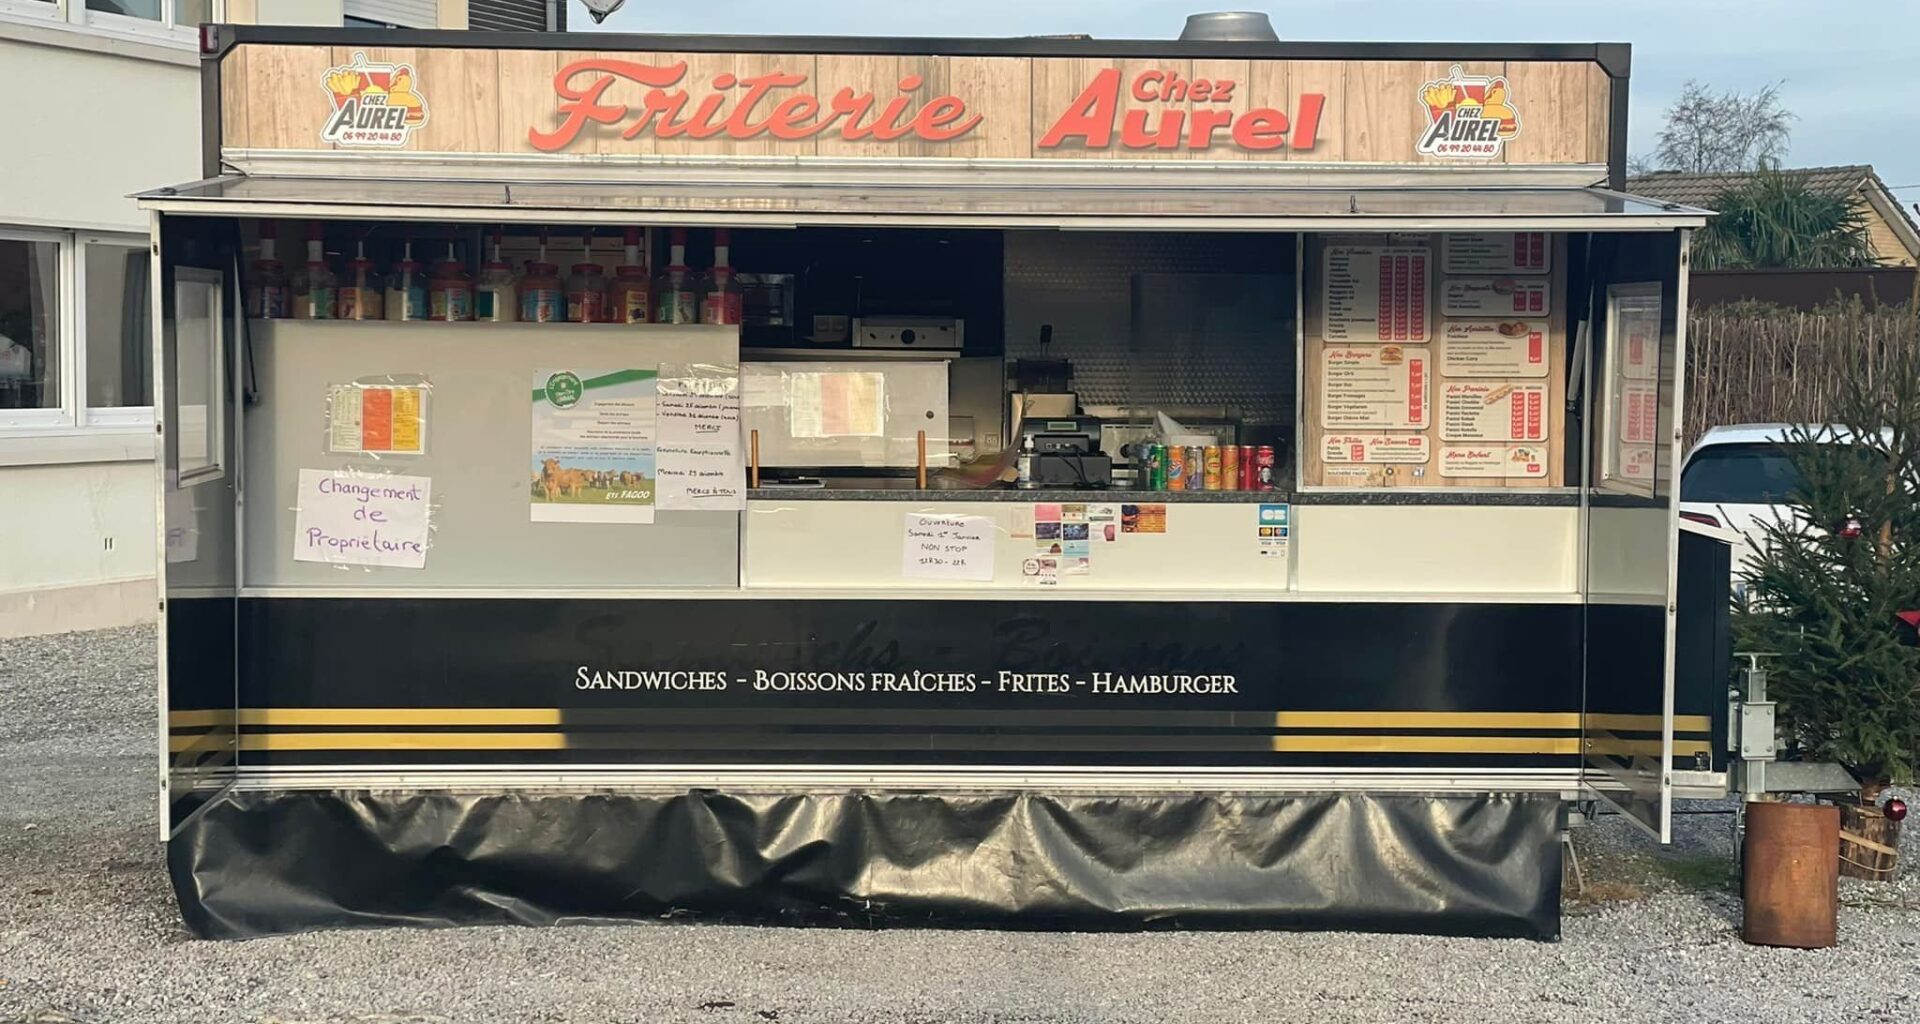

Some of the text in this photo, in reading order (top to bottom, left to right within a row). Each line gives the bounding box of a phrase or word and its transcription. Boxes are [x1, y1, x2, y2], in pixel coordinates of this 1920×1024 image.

[1132, 70, 1236, 102] Chez
[363, 95, 387, 106] CHEZ
[529, 59, 983, 151] Friterie
[328, 99, 407, 136] AUREL
[1038, 68, 1326, 153] Aurel
[1457, 108, 1481, 118] CHEZ
[342, 131, 354, 141] 06
[367, 131, 379, 141] 20
[1423, 111, 1500, 148] AUREL
[1437, 144, 1448, 153] 06
[1449, 144, 1460, 153] 99
[1460, 144, 1472, 153] 20
[1483, 144, 1495, 153] 80
[319, 478, 422, 503] Changement
[606, 491, 619, 500] ETS
[353, 505, 388, 523] de
[1262, 509, 1286, 520] CB
[919, 518, 965, 528] Ouverture
[921, 543, 967, 553] NON STOP
[574, 666, 728, 691] SANDWICHES
[752, 669, 865, 692] BOISSONS
[997, 671, 1071, 694] FRITES
[1091, 671, 1239, 694] HAMBURGER
